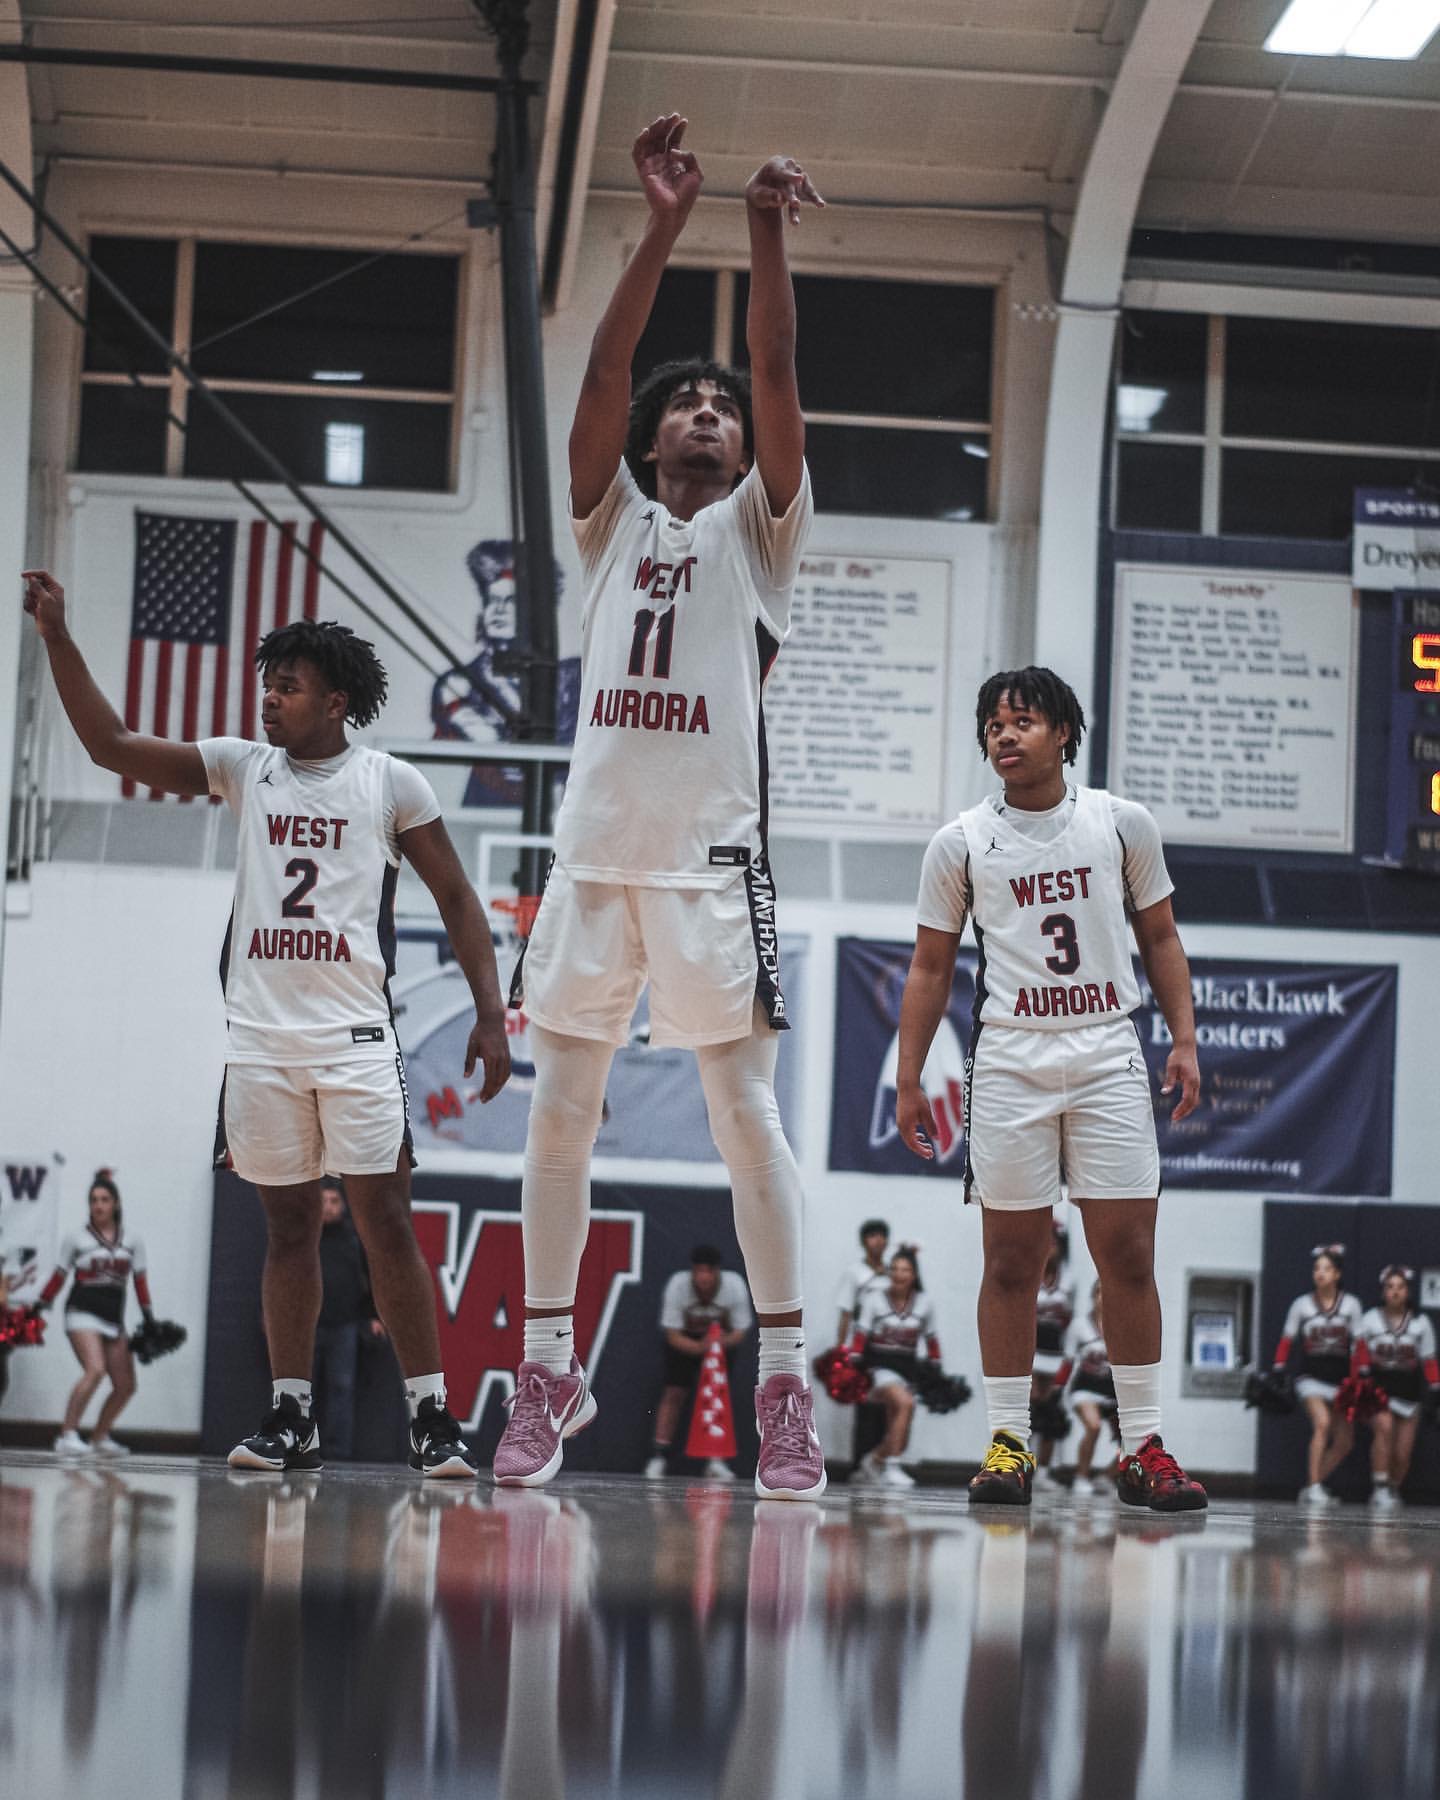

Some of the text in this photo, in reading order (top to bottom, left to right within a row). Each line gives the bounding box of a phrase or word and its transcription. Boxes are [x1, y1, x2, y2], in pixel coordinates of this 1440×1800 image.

[633, 556, 698, 601] WEST
[627, 604, 676, 680] 11
[590, 688, 711, 734] AURORA
[267, 814, 349, 850] WEST
[281, 857, 320, 919] 2
[1009, 867, 1092, 908] WEST
[248, 928, 352, 962] AURORA
[1039, 913, 1081, 976] 3
[1013, 981, 1121, 1017] AURORA
[1152, 1013, 1287, 1049] Bosters
